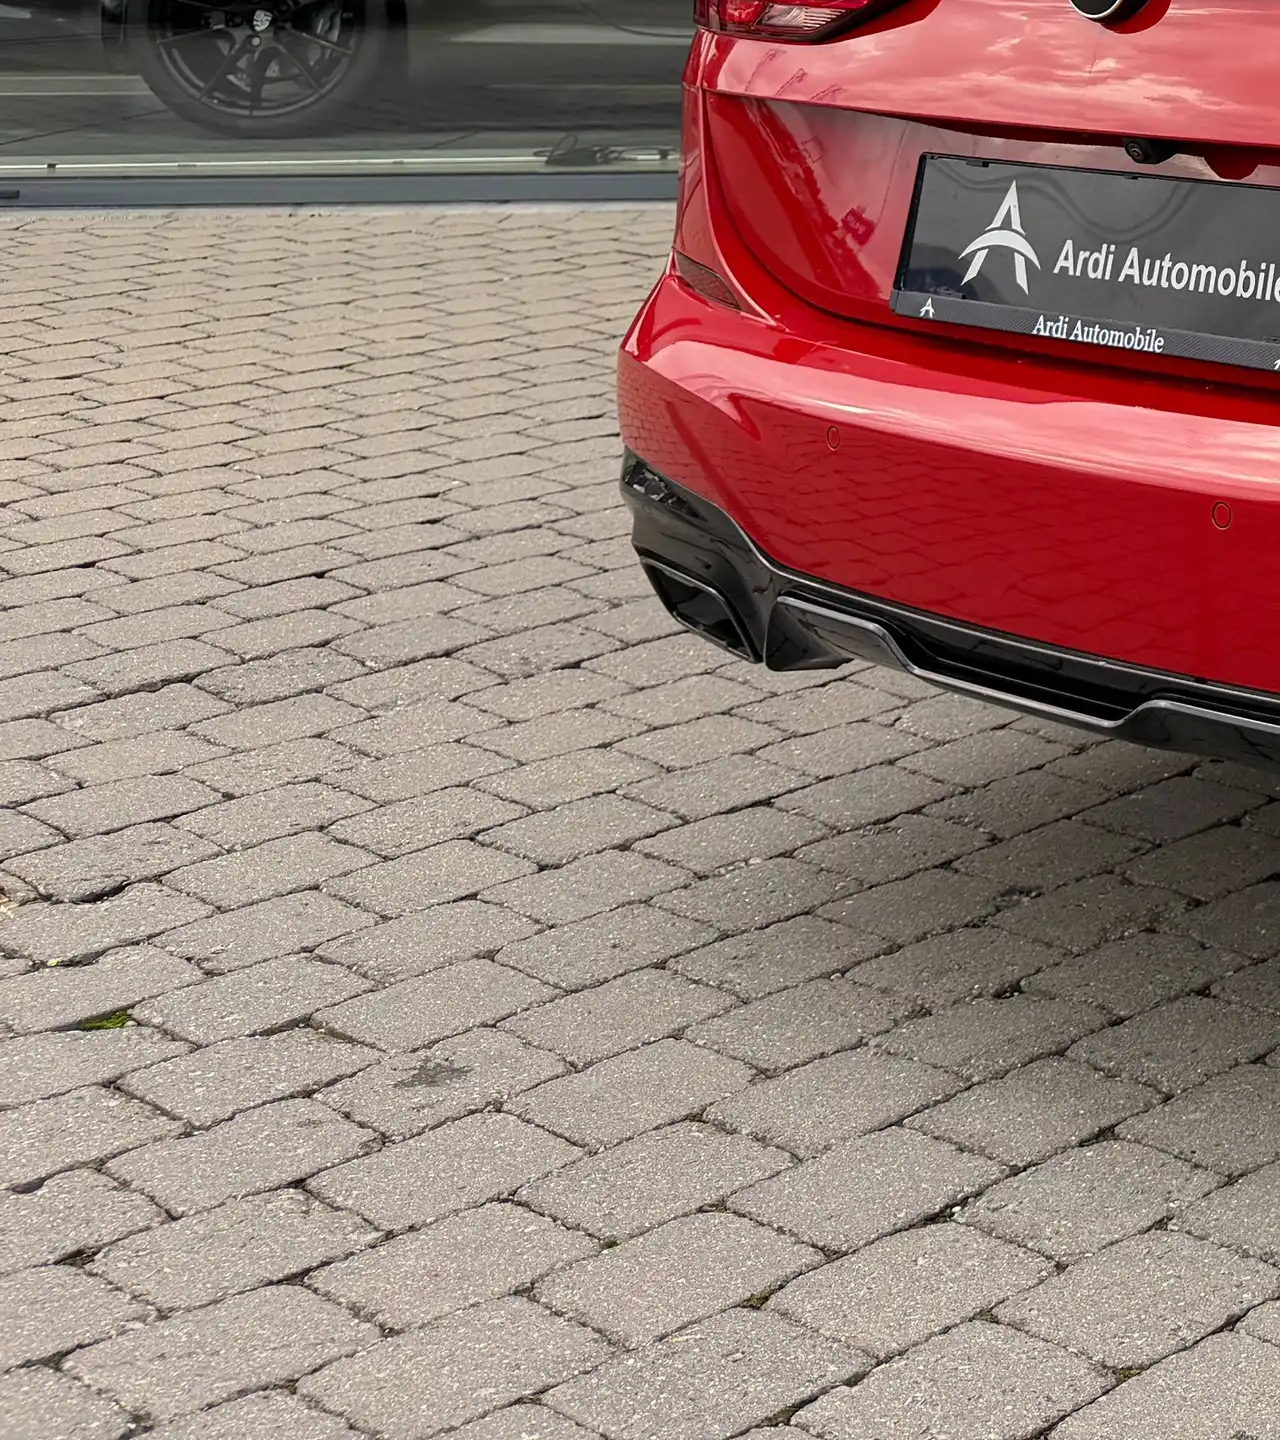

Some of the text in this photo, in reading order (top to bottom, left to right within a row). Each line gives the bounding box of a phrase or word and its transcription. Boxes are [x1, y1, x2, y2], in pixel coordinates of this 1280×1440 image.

[1053, 239, 1116, 281] Ardi
[1031, 314, 1165, 353] Ardi Automobile
